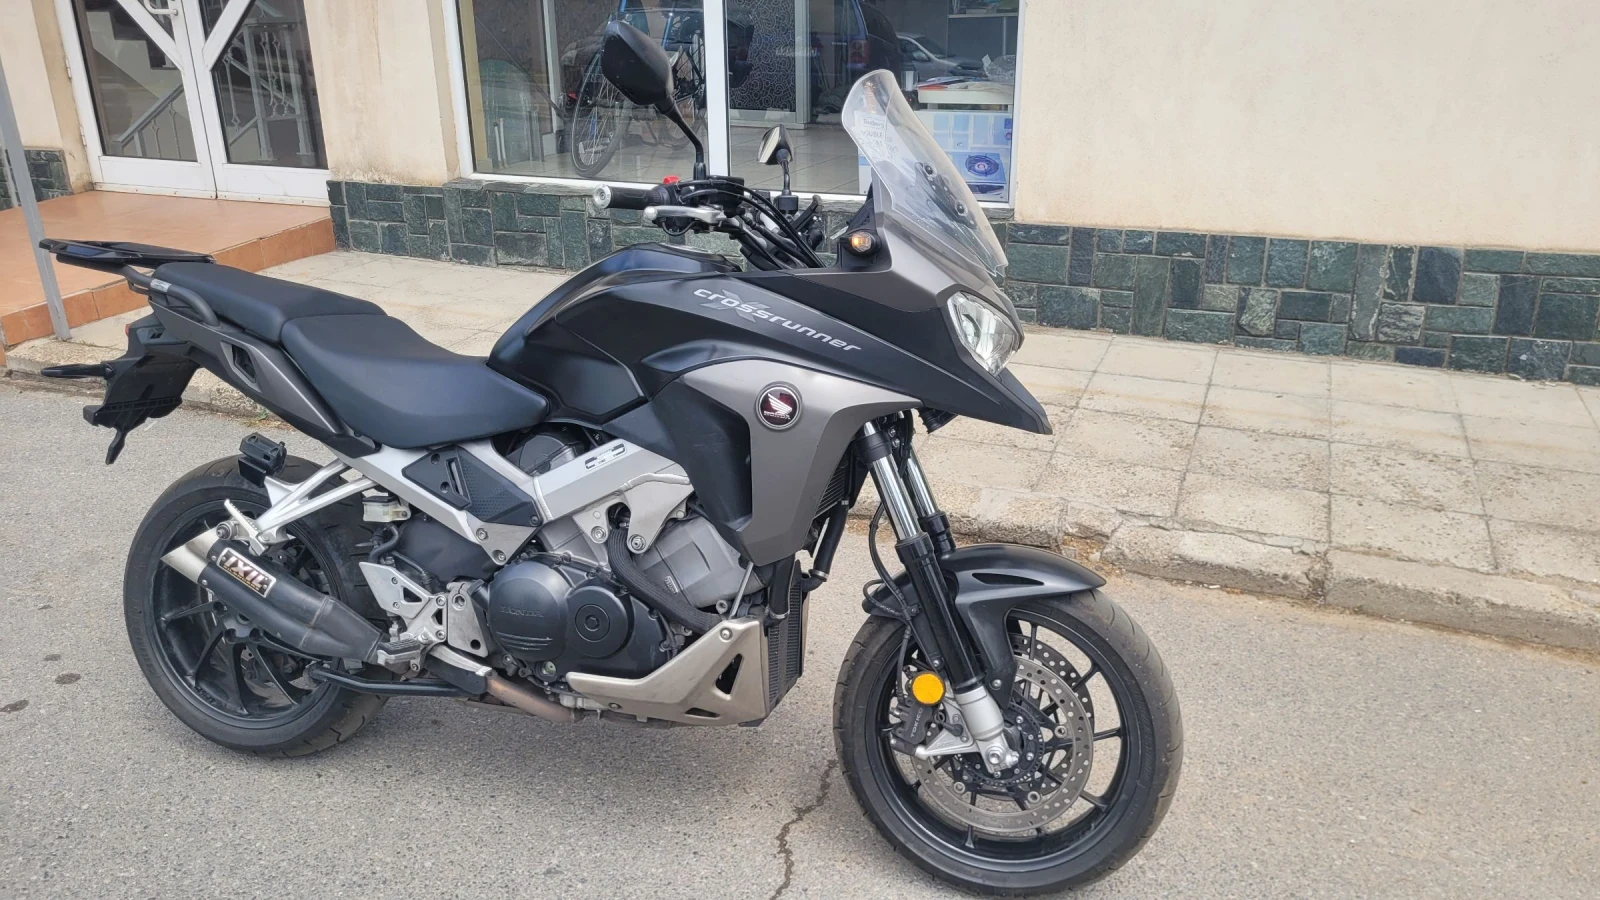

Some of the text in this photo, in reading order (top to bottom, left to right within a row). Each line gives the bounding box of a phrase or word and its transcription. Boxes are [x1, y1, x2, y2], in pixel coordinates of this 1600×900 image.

[693, 288, 862, 351] crossrunner
[763, 410, 791, 420] HONDA
[223, 556, 263, 587] IXIL
[500, 605, 545, 617] HONDA
[910, 708, 923, 739] TOKICO
